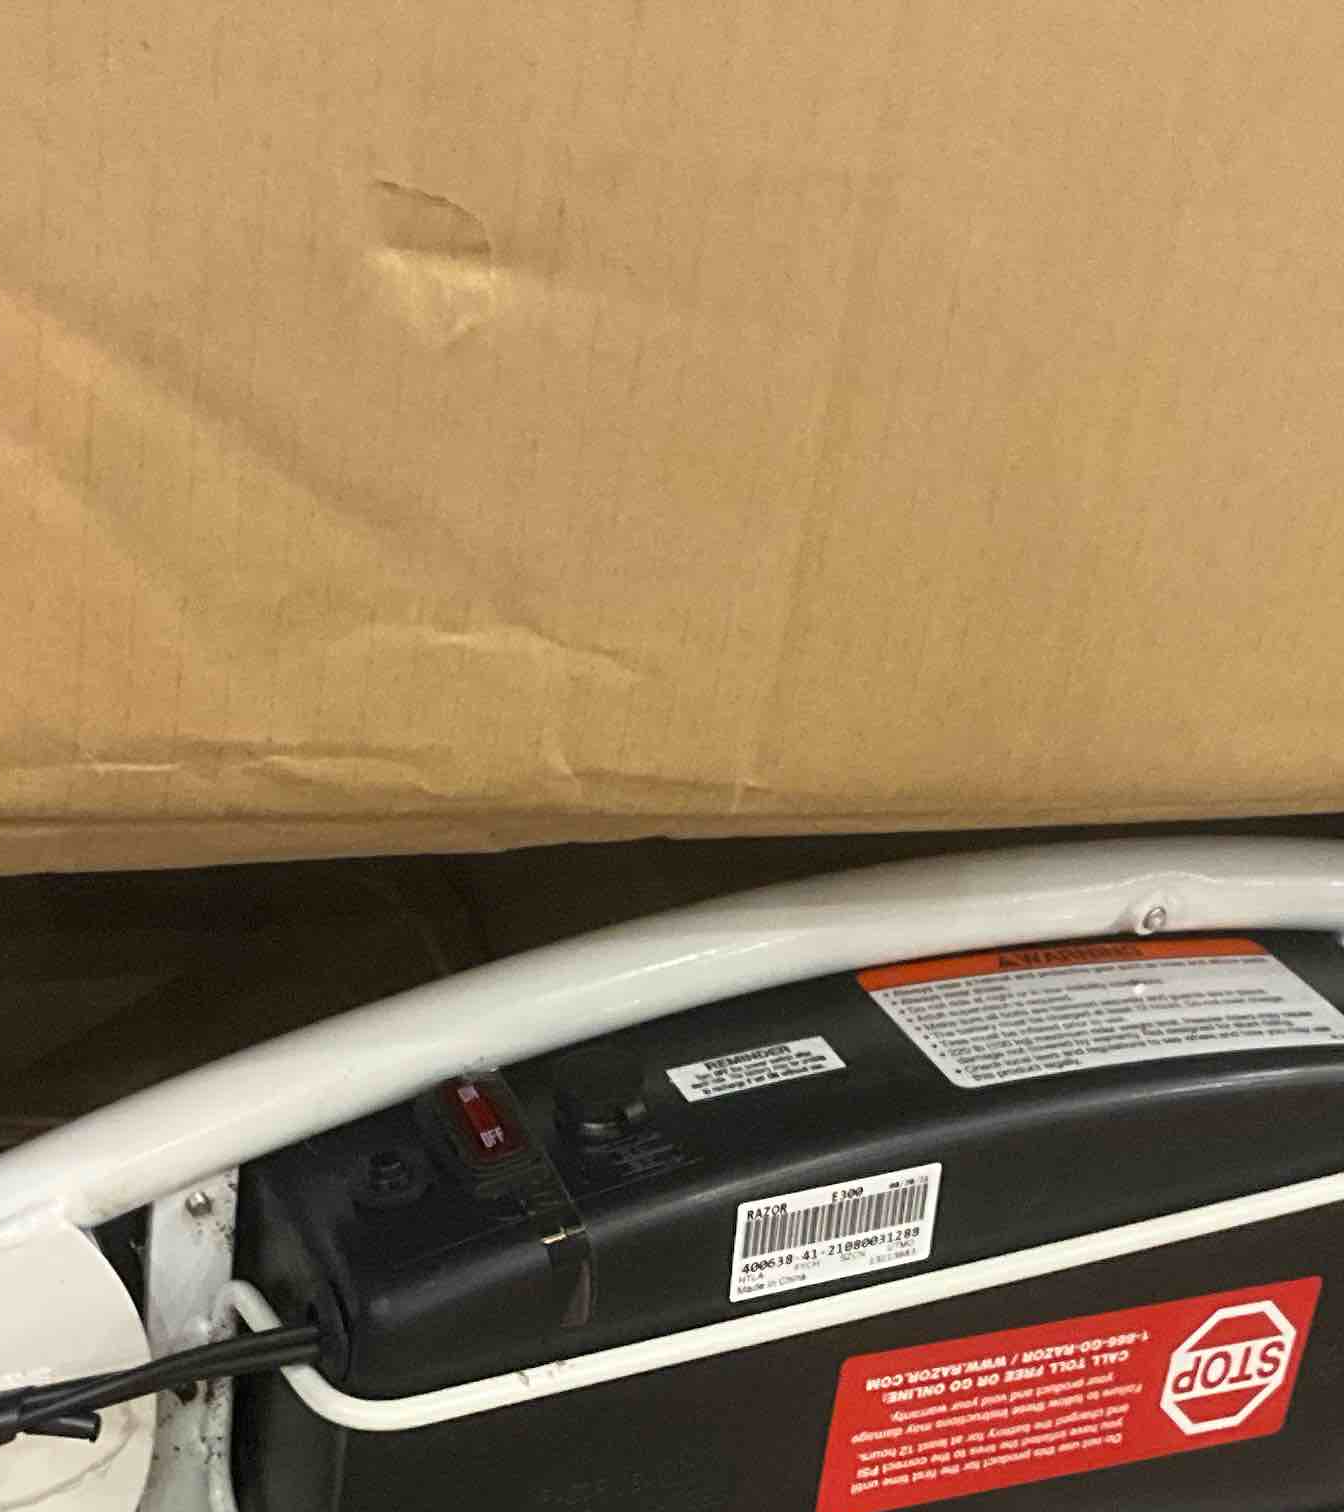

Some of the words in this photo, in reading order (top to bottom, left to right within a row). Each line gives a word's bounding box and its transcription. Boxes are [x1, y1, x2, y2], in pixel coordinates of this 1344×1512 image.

[705, 1046, 792, 1070] REMINDER
[479, 1126, 504, 1148] OFF
[746, 1202, 787, 1220] RAZOR
[831, 1186, 863, 1202] E300
[1009, 1353, 1019, 1366] /
[1047, 1356, 1088, 1374] TOLL
[1090, 1348, 1129, 1367] CALL
[1172, 1341, 1285, 1394] STOP
[864, 1355, 1007, 1391] WWW.RAZOR.COM
[975, 1372, 1000, 1387] OR
[1004, 1364, 1044, 1381] FREE
[879, 1382, 946, 1405] ONLINE:
[948, 1377, 973, 1392] GO
